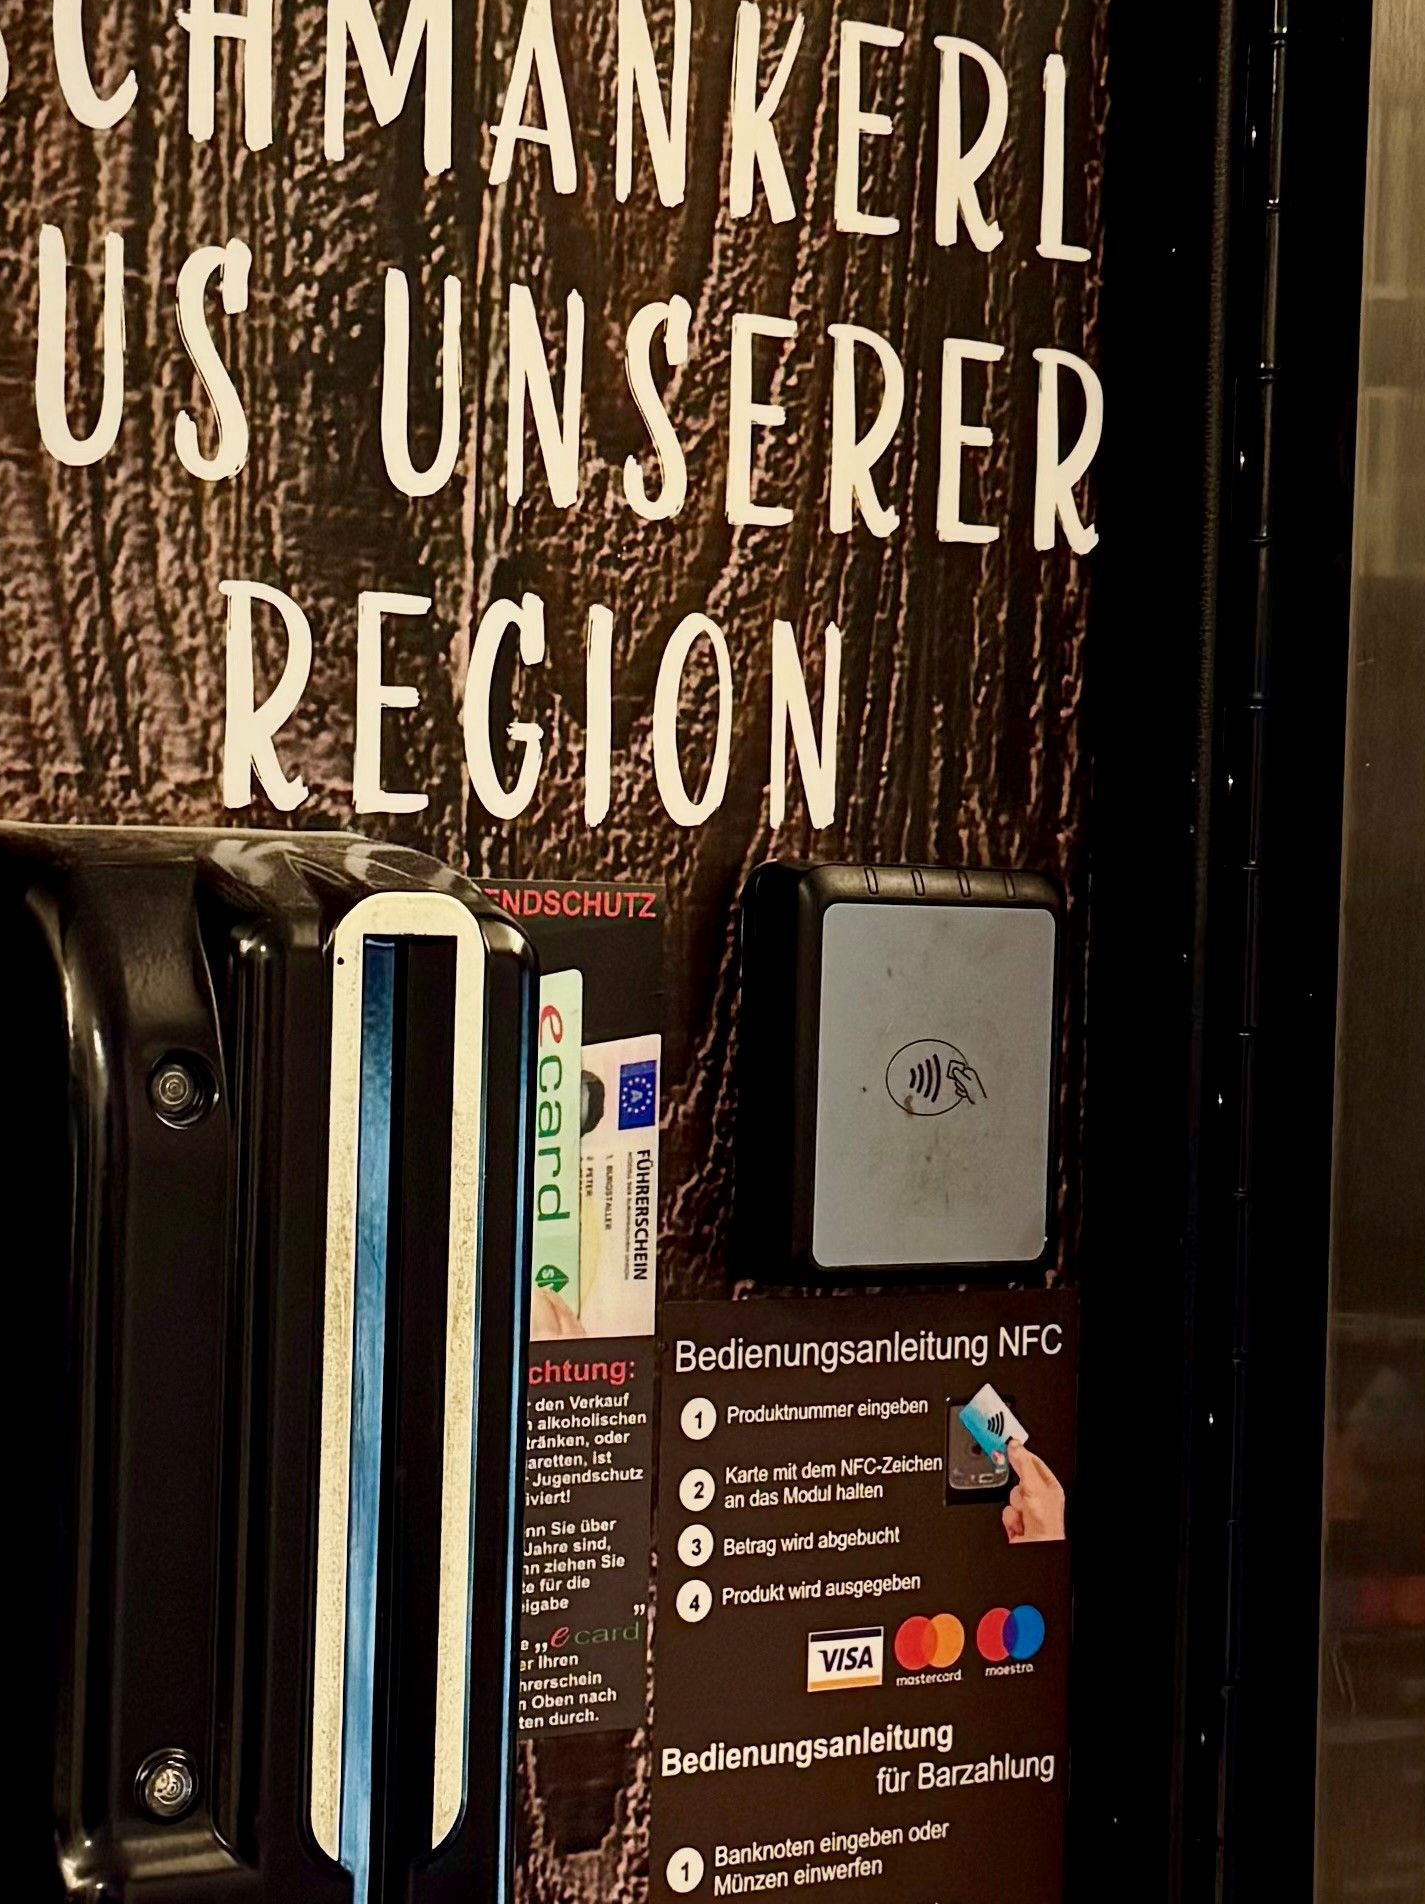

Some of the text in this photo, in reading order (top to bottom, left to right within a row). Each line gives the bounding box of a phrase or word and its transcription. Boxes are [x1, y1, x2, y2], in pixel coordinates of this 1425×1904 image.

[381, 266, 1104, 555] UNSERER
[219, 579, 842, 831] REGION
[483, 887, 657, 919] NDSCHUTZ
[633, 1149, 654, 1280] FÜHRERSCHEIN
[675, 1323, 1064, 1374] Bedienungsanleitung NFC
[528, 1359, 635, 1386] chtung:
[535, 1397, 565, 1412] den
[569, 1392, 630, 1411] Verkauf
[726, 1400, 854, 1426] Produktnummer
[857, 1397, 929, 1422] eingeben
[537, 1412, 647, 1432] alkoholischen
[594, 1430, 630, 1446] oder
[592, 1451, 612, 1464] ist
[725, 1463, 769, 1486] Karte
[773, 1461, 798, 1482] mit
[802, 1459, 836, 1480] dem
[840, 1453, 944, 1478] NFC-Zeichen
[532, 1467, 645, 1488] Jugendschutz
[724, 1481, 884, 1509] an das Modul halten
[550, 1521, 576, 1536] Sie
[580, 1518, 617, 1534] über
[572, 1536, 612, 1553] sind,
[723, 1535, 777, 1560] Betrag
[781, 1532, 815, 1553] wird
[818, 1525, 900, 1553] abgebucht
[543, 1556, 597, 1574] ziehen
[601, 1553, 626, 1569] Sie
[540, 1578, 562, 1593] für
[566, 1576, 591, 1590] die
[722, 1582, 785, 1606] Produkt
[788, 1579, 822, 1601] wird
[825, 1573, 922, 1602] ausgegeben
[538, 1653, 579, 1670] Ihren
[817, 1645, 874, 1673] VISA
[531, 1693, 574, 1710] Oben
[578, 1687, 617, 1704] nach
[548, 1708, 600, 1727] durch.
[661, 1724, 954, 1777] Bedienungsanleitung
[876, 1754, 1055, 1795] für Barzahlung
[714, 1840, 815, 1867] Banknoten
[819, 1826, 904, 1856] eingeben
[908, 1820, 949, 1843] oder
[714, 1858, 883, 1897] Münzen einwerfen
